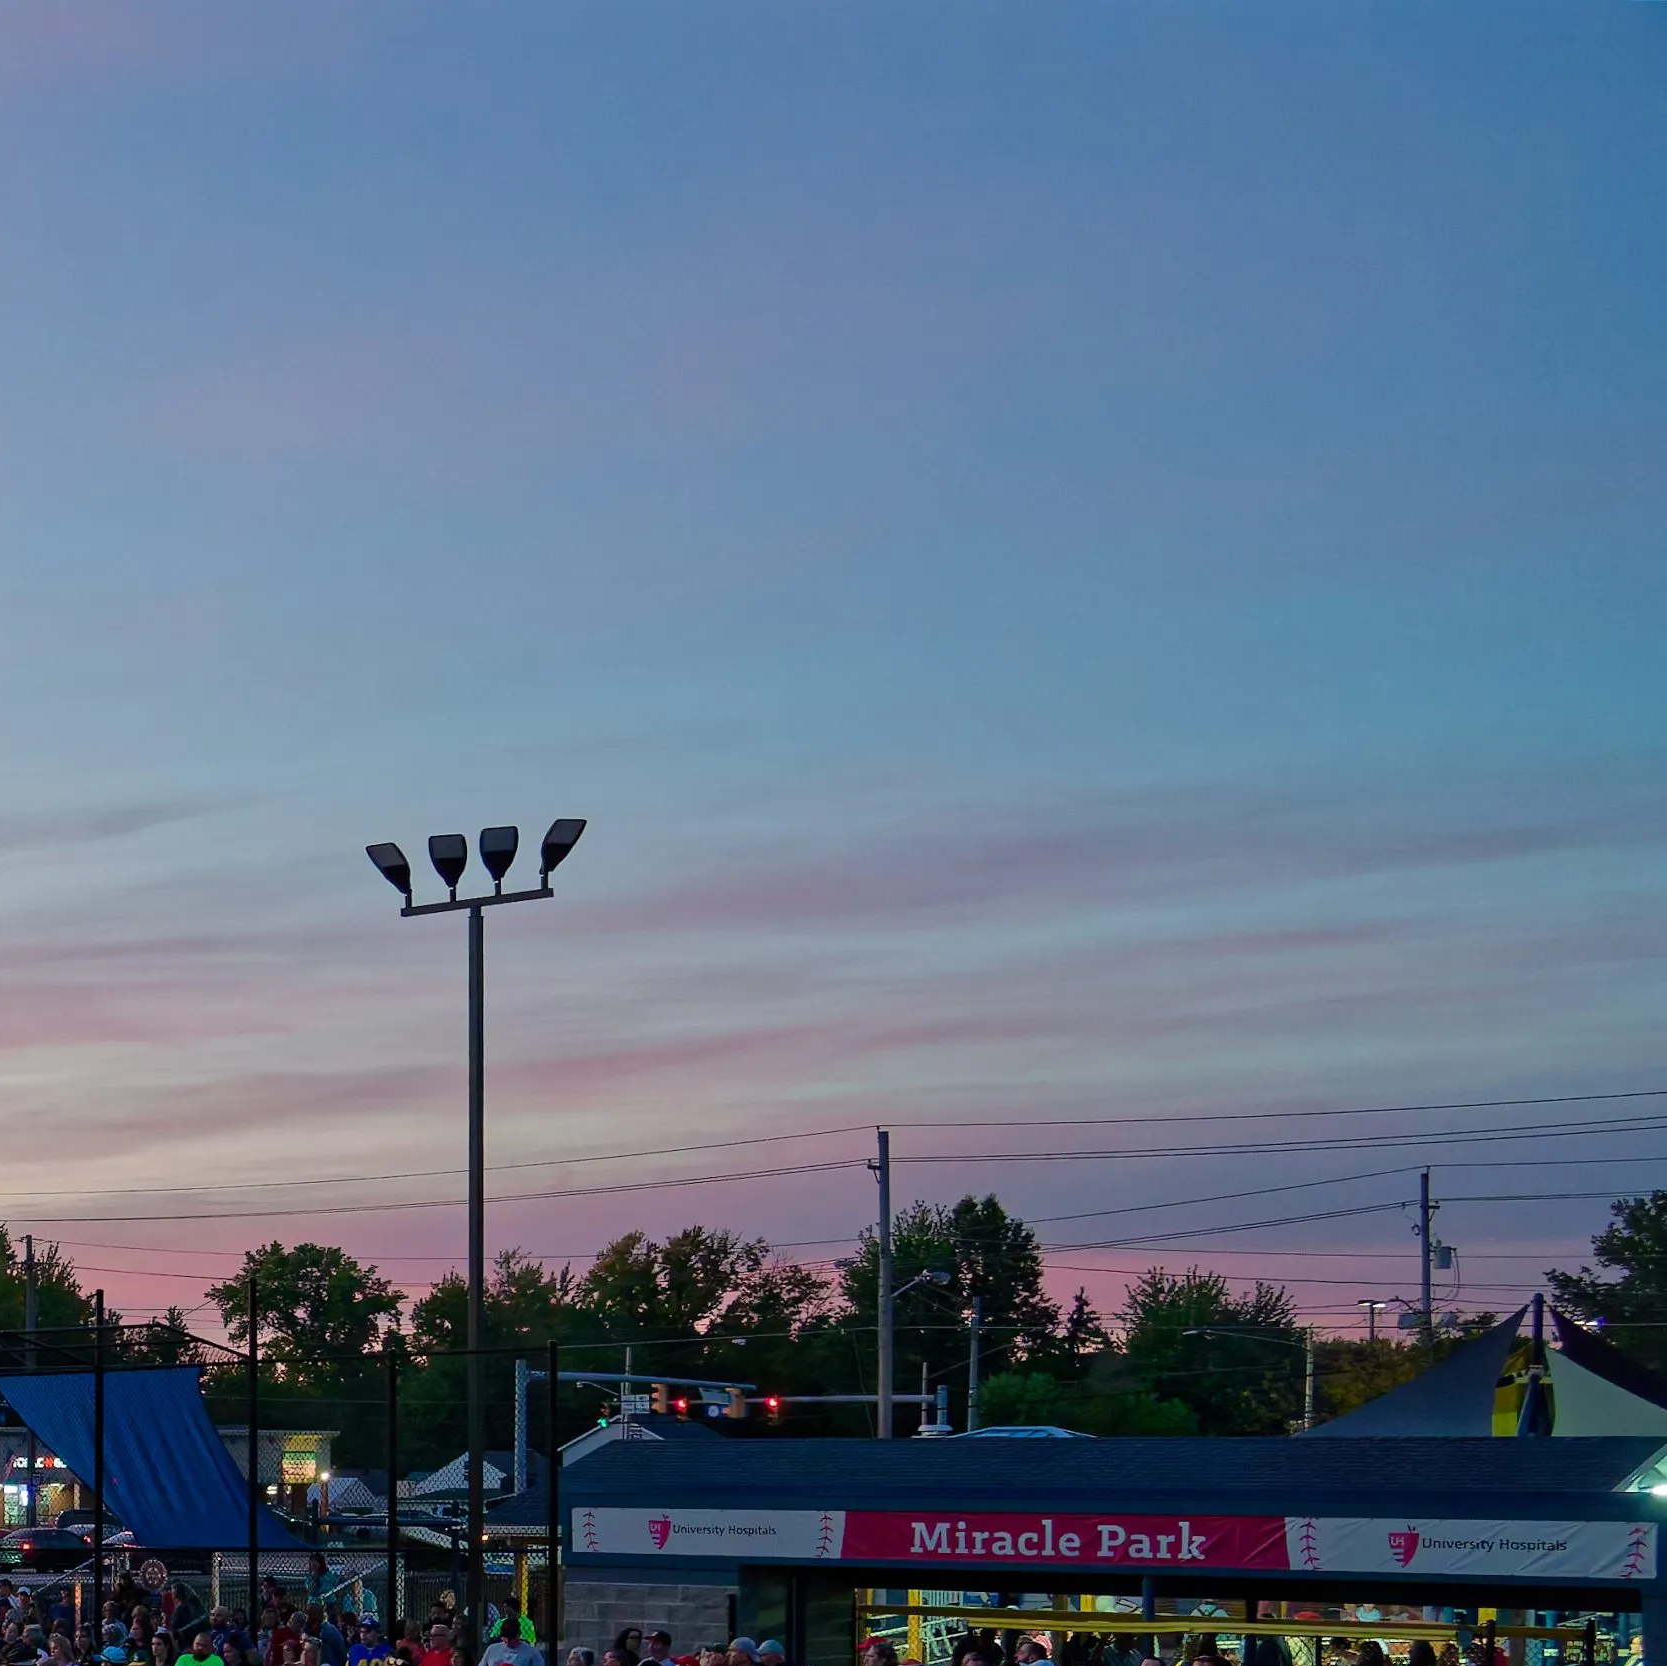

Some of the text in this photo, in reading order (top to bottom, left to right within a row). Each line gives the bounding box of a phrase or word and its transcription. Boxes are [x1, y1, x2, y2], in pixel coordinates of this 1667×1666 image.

[672, 1524, 777, 1537] University Hospitals
[910, 1519, 1206, 1562] Miracle Park
[1422, 1537, 1567, 1552] University Hospitals
